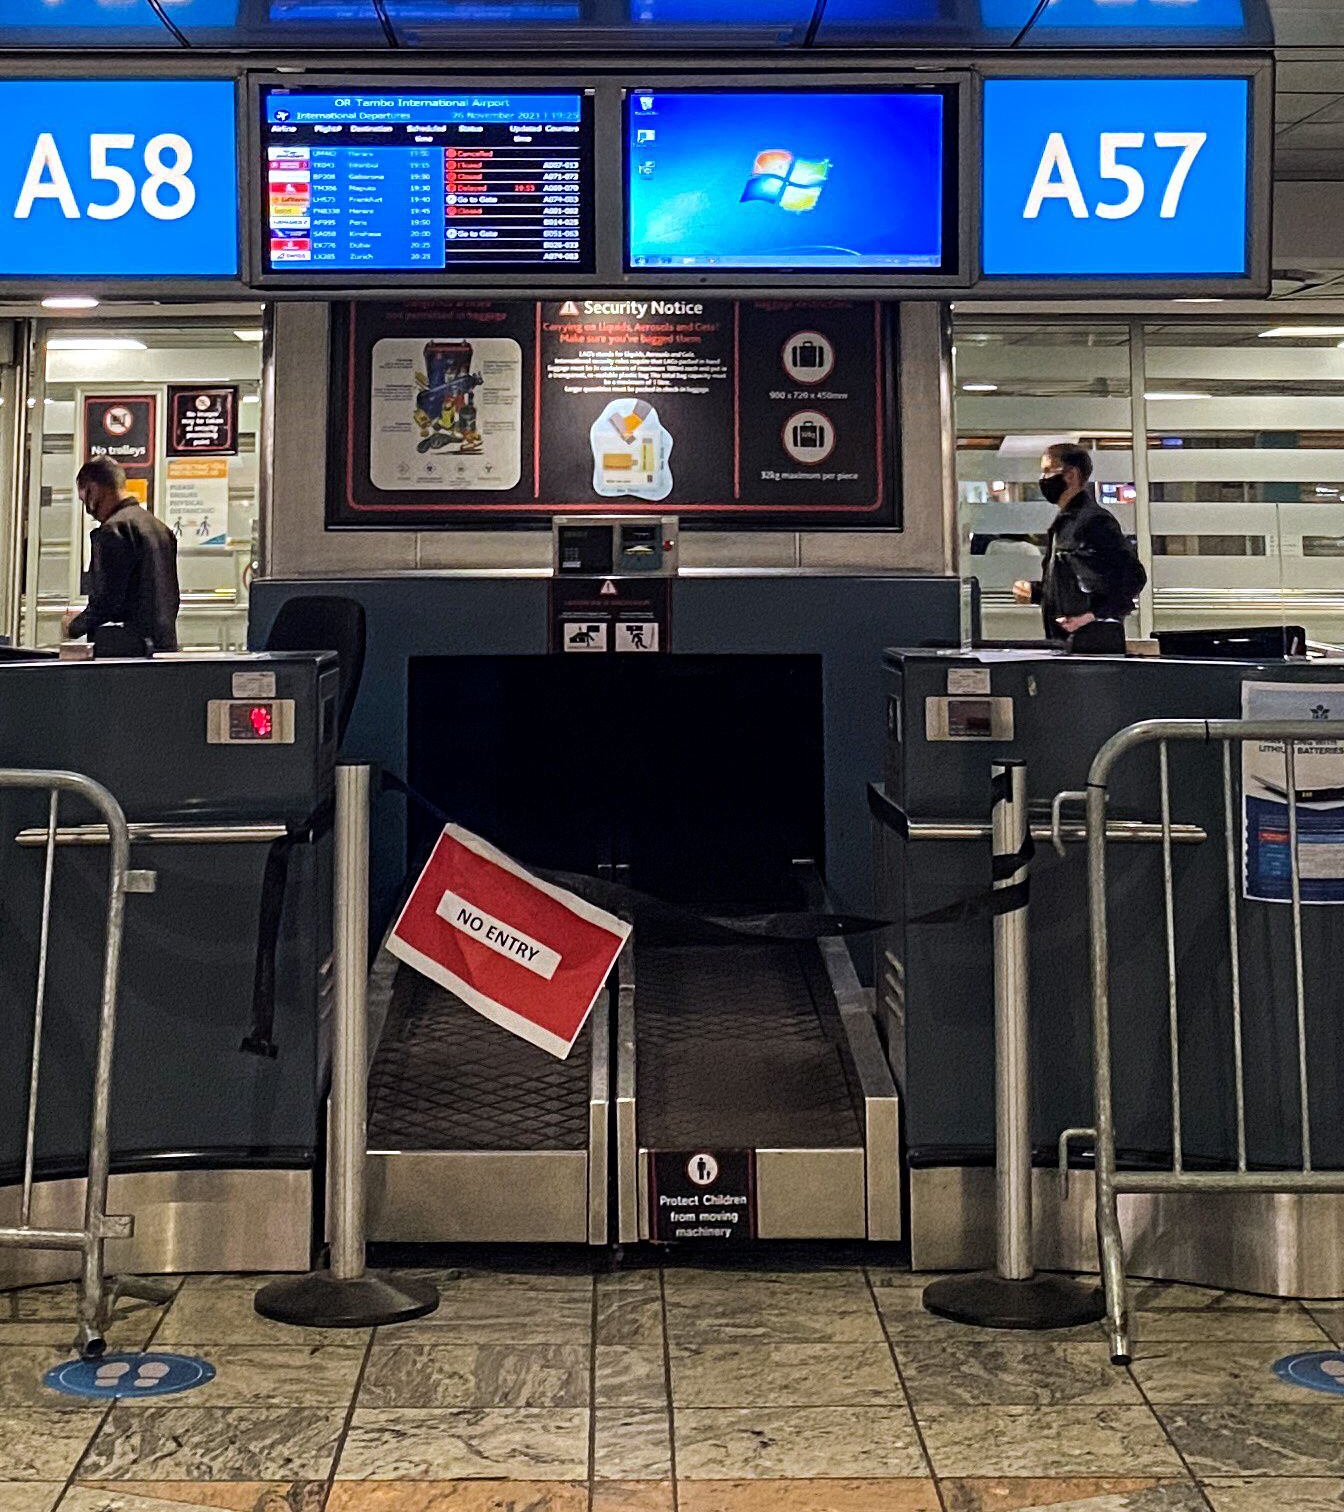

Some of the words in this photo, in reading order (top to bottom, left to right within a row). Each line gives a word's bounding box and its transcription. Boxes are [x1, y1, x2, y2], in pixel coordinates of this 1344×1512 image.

[335, 98, 351, 107] OR
[355, 98, 394, 107] Tambo
[398, 98, 468, 107] International
[472, 98, 510, 109] Airport
[14, 132, 197, 220] A58
[1022, 132, 1208, 219] A57
[584, 301, 647, 319] Security
[651, 301, 703, 314] Notice
[91, 446, 106, 455] No
[108, 445, 146, 457] trolleys
[1297, 746, 1344, 755] BATTERIES
[457, 908, 484, 931] NO
[486, 925, 540, 962] ENTRY
[660, 1195, 698, 1205] Protect
[703, 1195, 747, 1205] Children
[670, 1211, 695, 1222] from
[699, 1211, 739, 1223] moving
[676, 1227, 731, 1238] machinery
